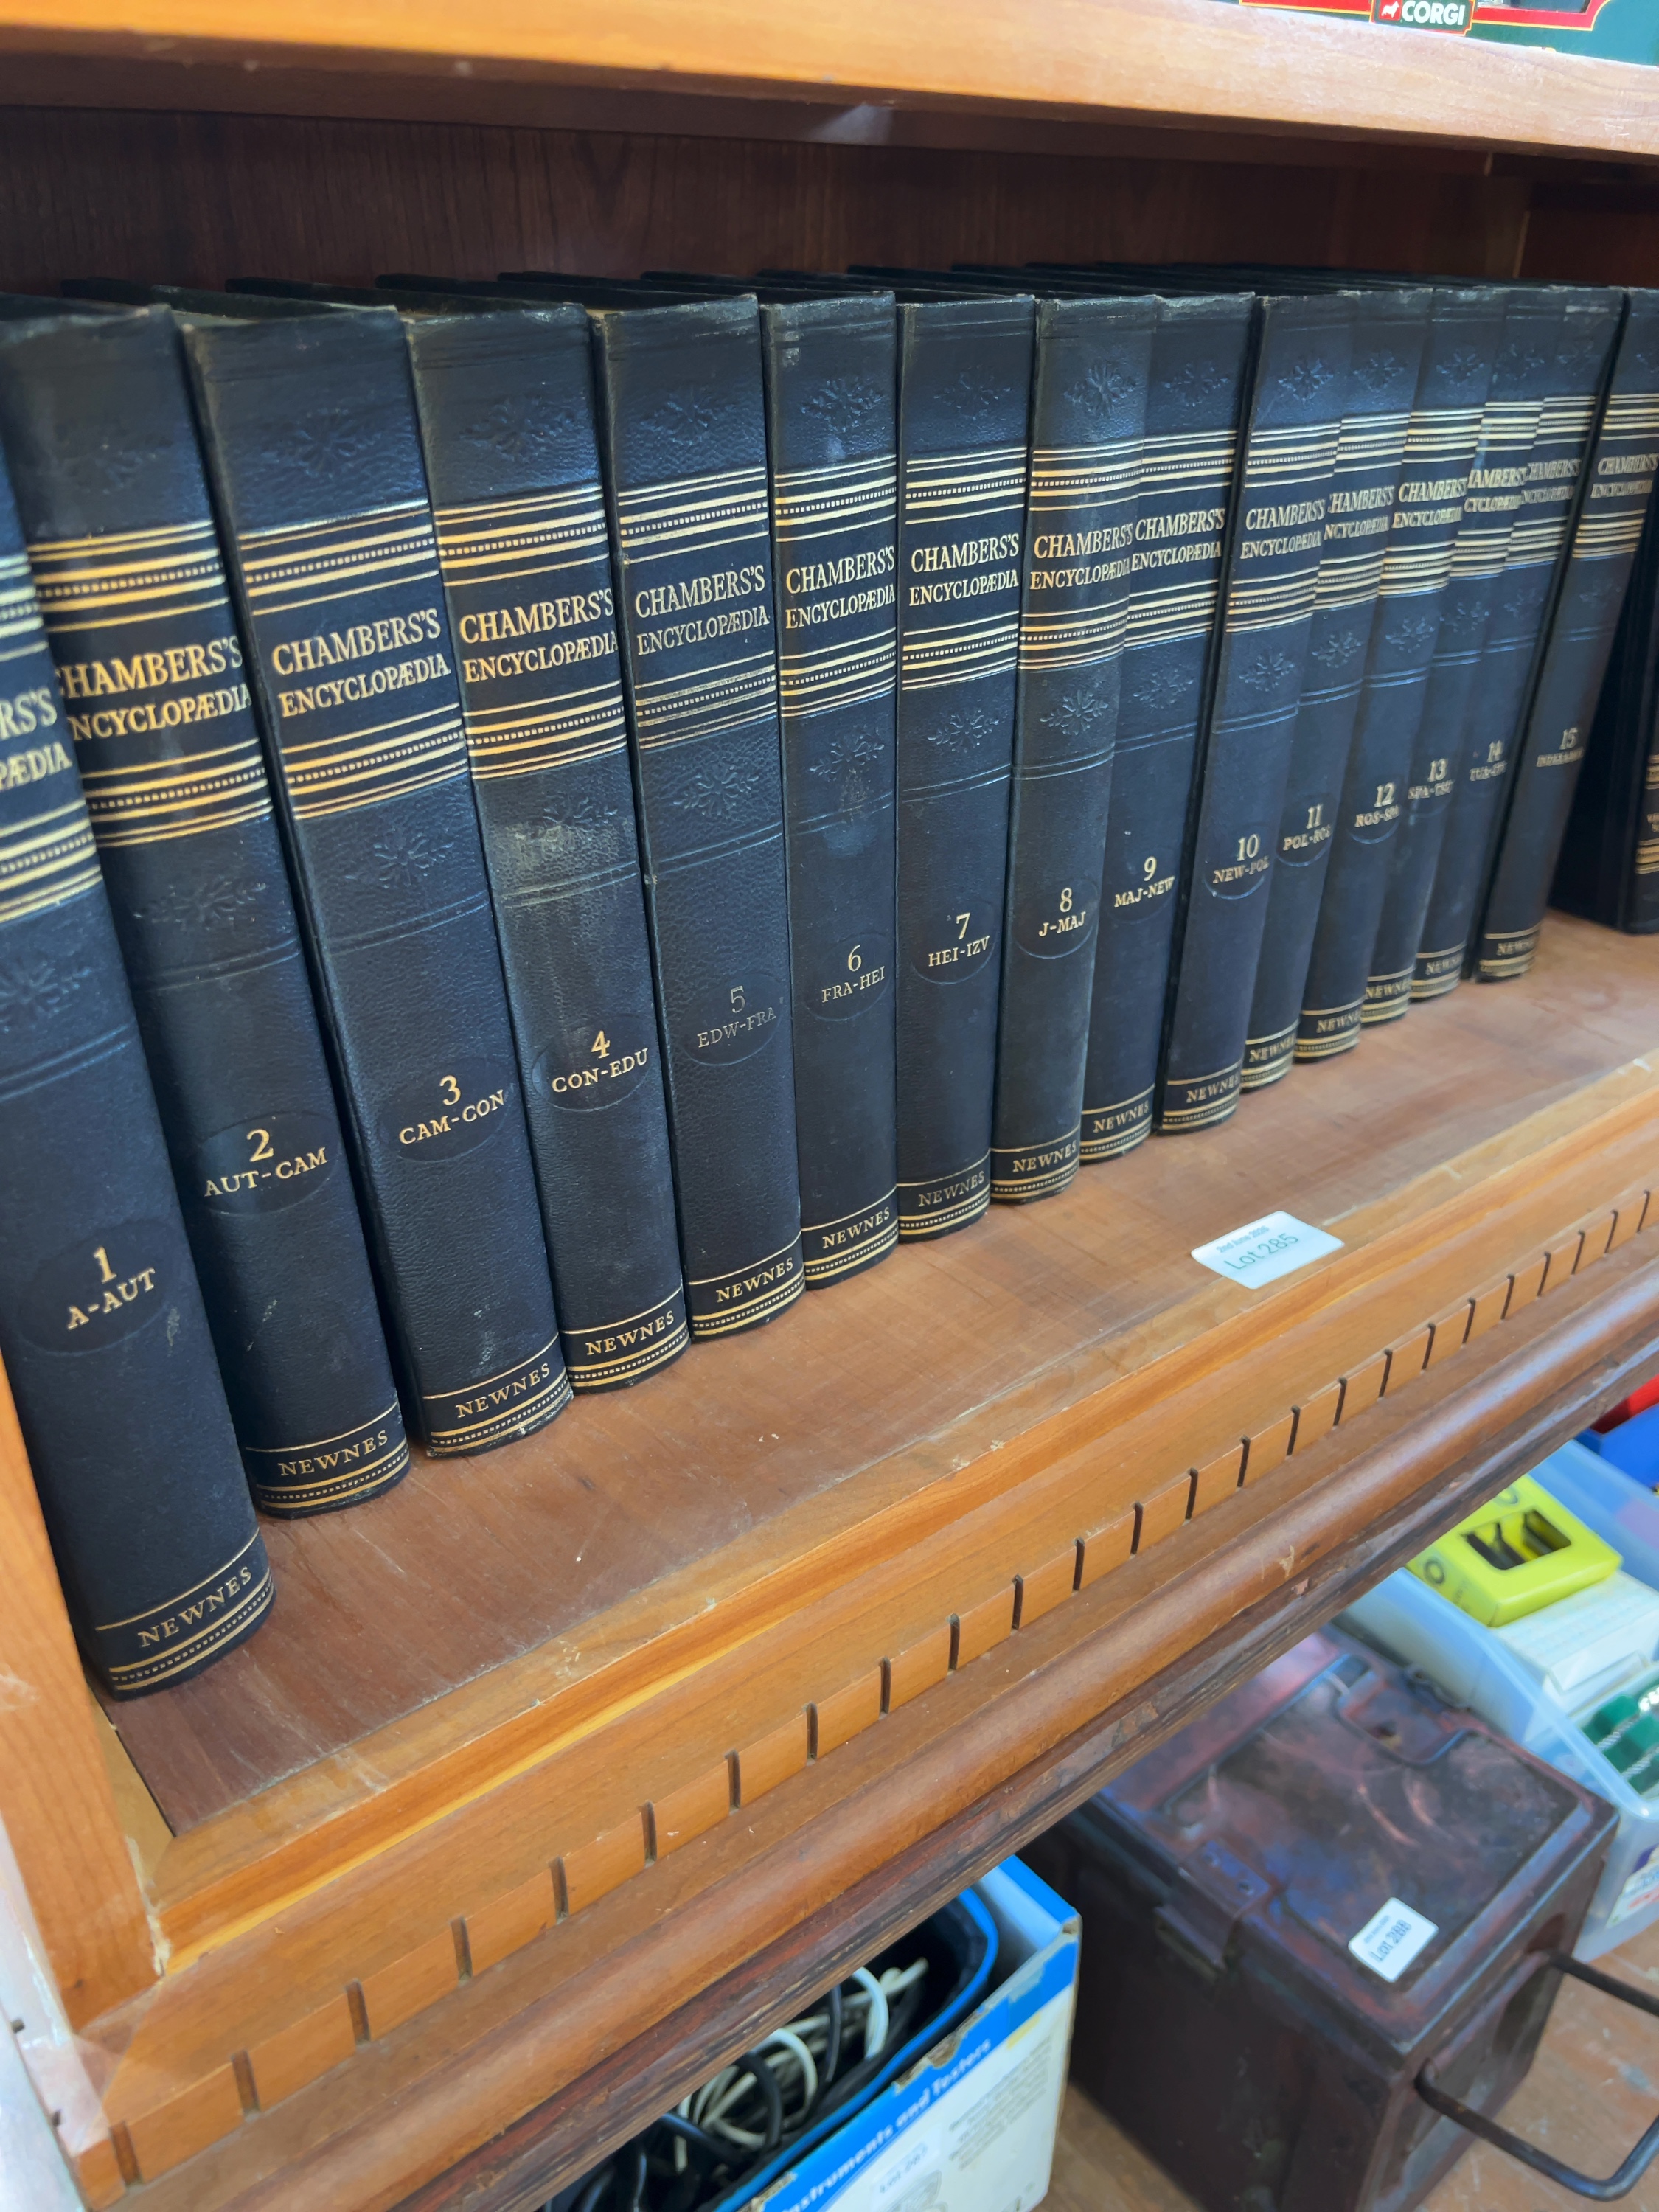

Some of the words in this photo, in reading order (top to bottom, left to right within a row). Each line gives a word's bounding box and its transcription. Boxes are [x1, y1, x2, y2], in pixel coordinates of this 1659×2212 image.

[1402, 0, 1466, 25] CORGI
[1245, 498, 1326, 531] CHAMBERS'S
[1327, 484, 1396, 514] HAMBERS'S
[1034, 522, 1133, 559] CHAMBERS'S
[1135, 507, 1225, 541] CHAMBERS'S
[1323, 515, 1391, 540] NCYCLOPÆDIA
[786, 546, 895, 594] CHAMBERS'S
[911, 533, 1020, 574] CHAMBERS'S
[635, 564, 765, 619] CHAMBERS'S
[459, 587, 615, 644] CHAMBERS'S
[271, 607, 442, 676] CHAMBERS'S
[55, 635, 243, 698] HAMBERS'S
[278, 653, 451, 718] ENCYCLOPÆDIA
[66, 682, 252, 740] NCYCLOPÆDIA
[1559, 727, 1578, 751] 15
[1427, 758, 1448, 782] 13
[1374, 782, 1396, 808] 12
[1306, 803, 1323, 830] 11
[1236, 833, 1261, 862] 10
[1143, 855, 1158, 882] 9
[1059, 887, 1074, 913] 8
[1113, 875, 1176, 908] MAJ-NEW
[955, 911, 972, 940] 7
[1038, 911, 1086, 937] J-MAJ
[846, 944, 863, 972] 6
[928, 935, 991, 967] HEI-IZV
[729, 984, 746, 1014] 5
[821, 965, 886, 1004] FRA-HEI
[1365, 978, 1411, 1000] NEWNE
[697, 1006, 777, 1048] EDW-FRA
[1316, 1008, 1362, 1034] NEWNE
[591, 1030, 611, 1059] 4
[551, 1047, 649, 1093] CON-EDU
[439, 1074, 462, 1106] 3
[398, 1089, 505, 1145] CAM-CON
[1093, 1099, 1150, 1134] NEWNES
[246, 1128, 275, 1162] 2
[1012, 1139, 1077, 1174] NEWNES
[204, 1147, 328, 1197] AUT-CAM
[918, 1169, 985, 1207] NEWNES
[822, 1206, 891, 1249] NEWNES
[93, 1246, 117, 1284] 1
[1224, 1251, 1265, 1270] Lot
[1257, 1232, 1298, 1254] 285
[715, 1256, 794, 1303] NEWNES
[66, 1267, 156, 1331] A-AUT
[585, 1310, 675, 1356] NEWNES
[455, 1361, 551, 1419] NEWNES
[278, 1429, 389, 1477] NEWNES
[137, 1565, 251, 1648] NEWNES
[1368, 1940, 1394, 1962] Lot
[782, 2124, 894, 2212] nstruments
[896, 2087, 931, 2127] and
